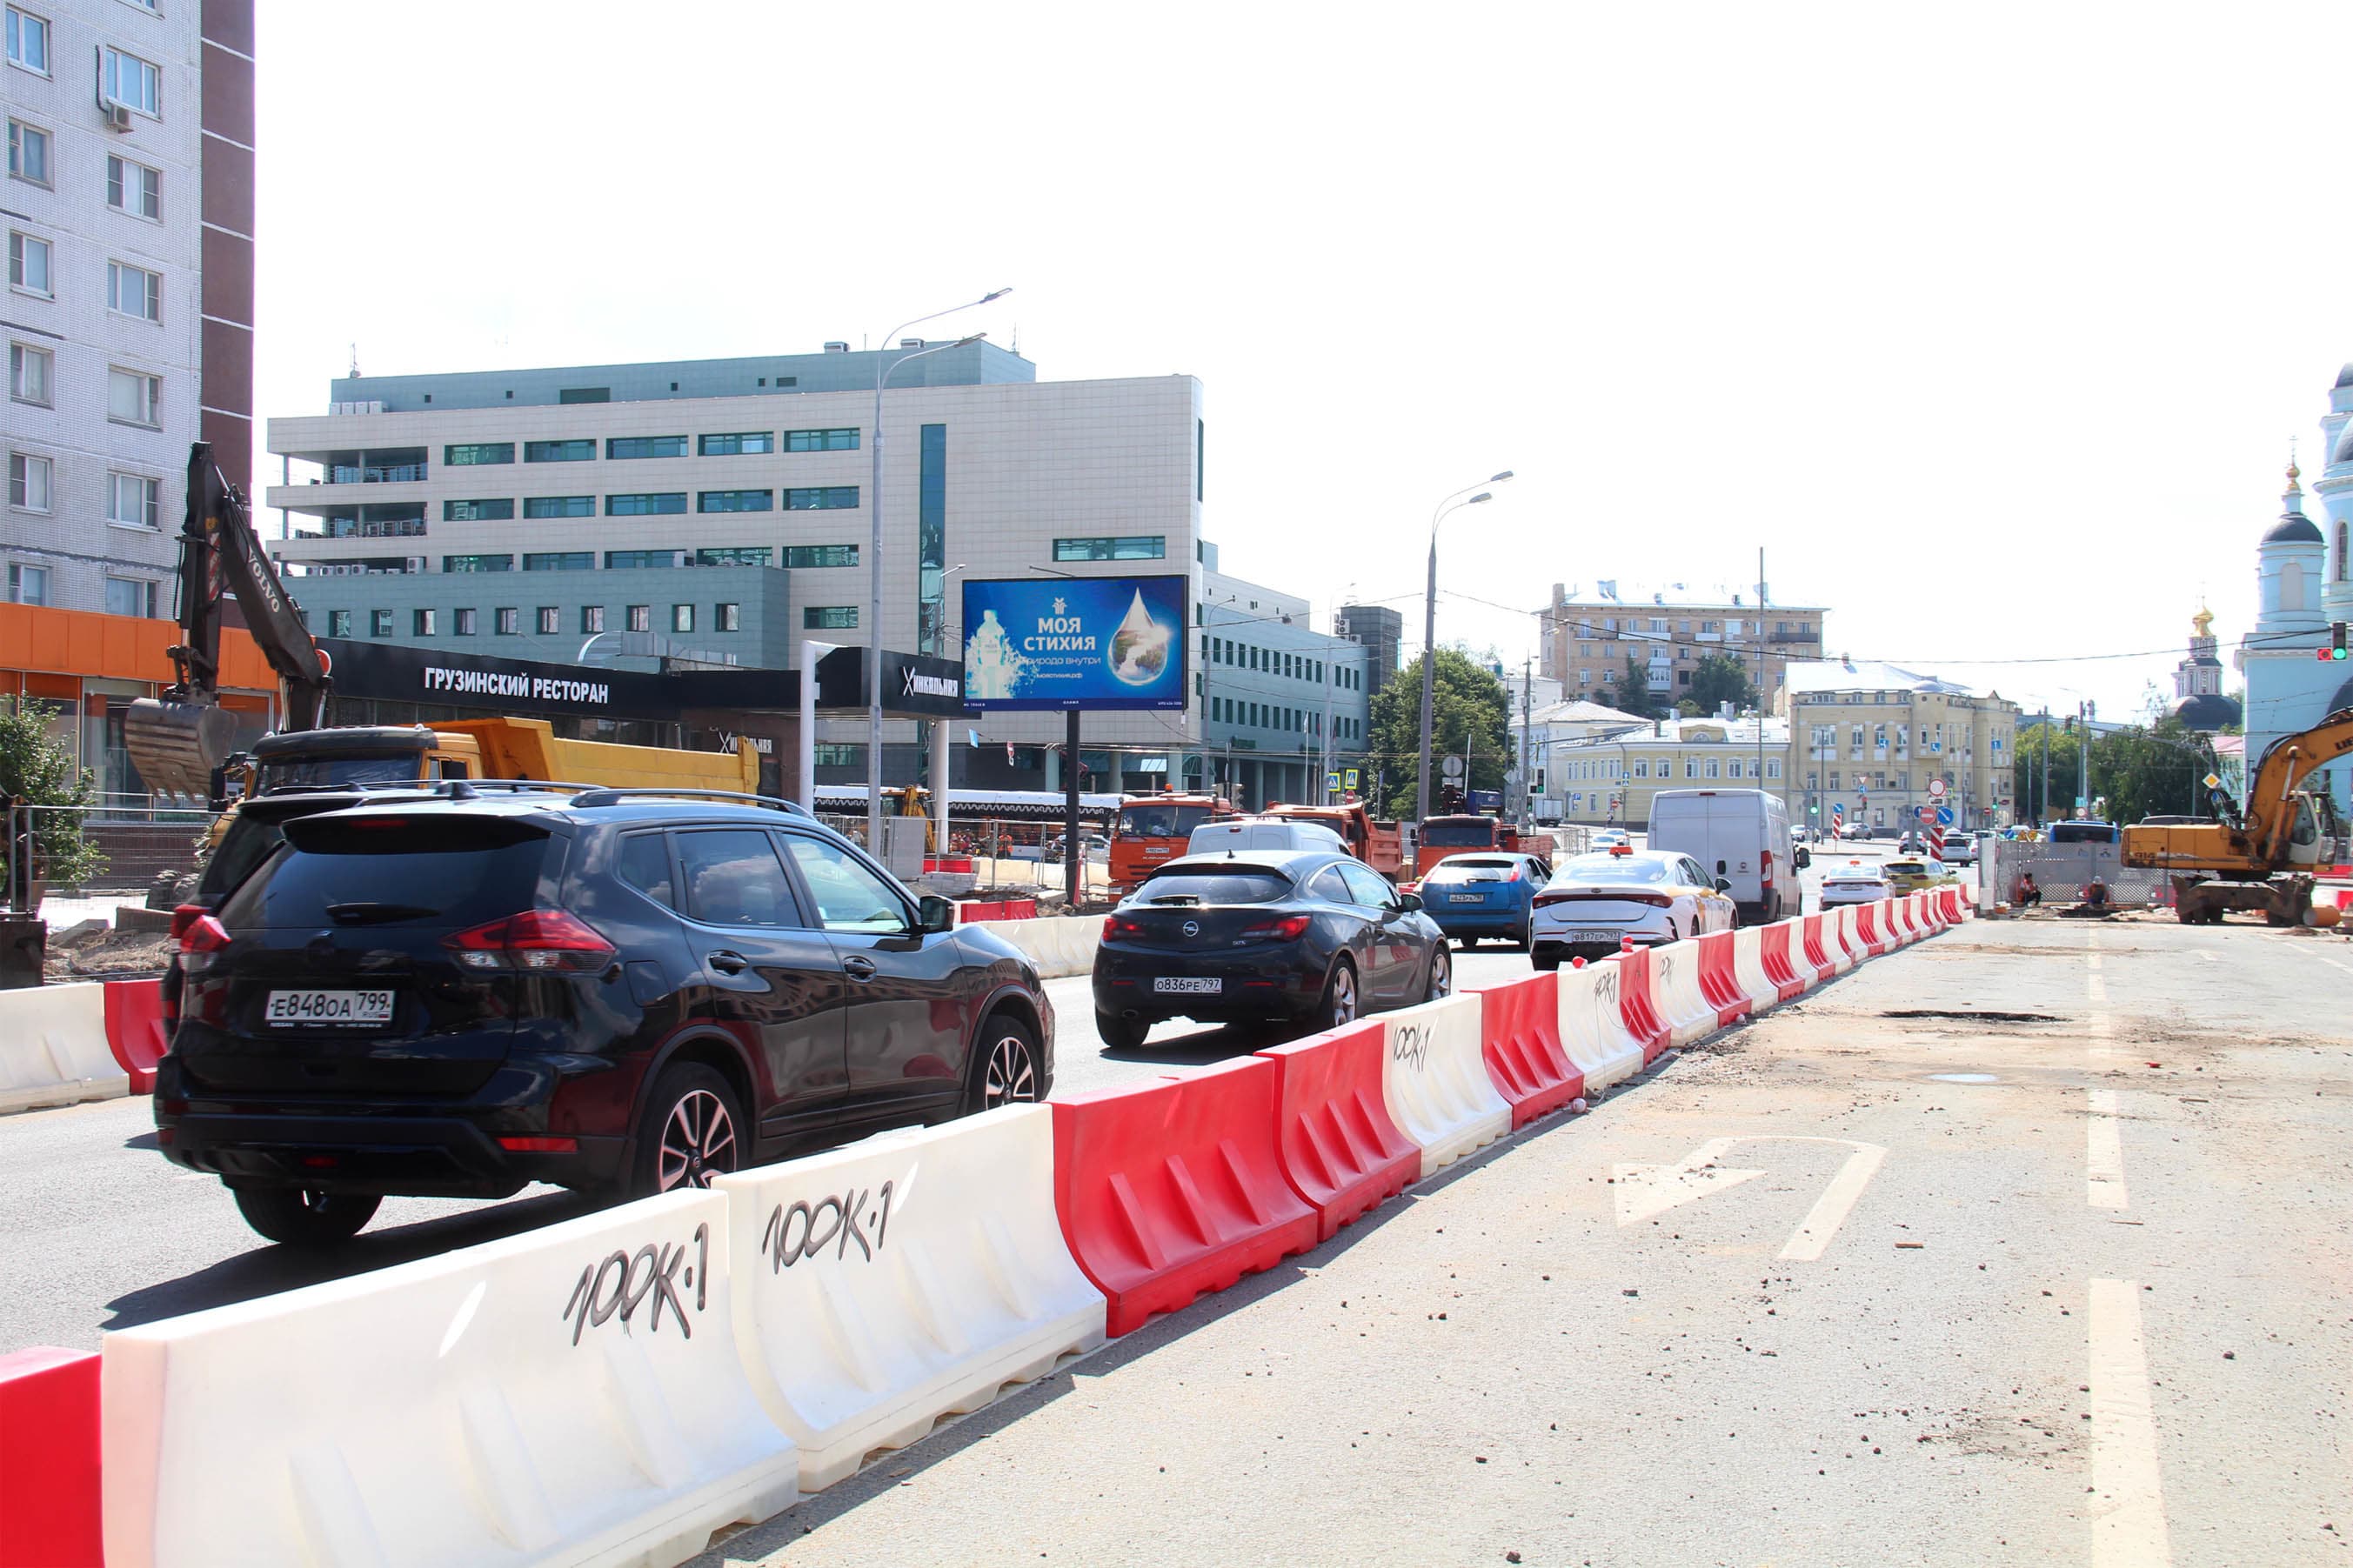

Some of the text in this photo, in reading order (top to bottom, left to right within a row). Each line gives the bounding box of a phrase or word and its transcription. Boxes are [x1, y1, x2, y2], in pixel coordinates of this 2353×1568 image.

[248, 544, 279, 613] VOLVO
[1038, 617, 1081, 634] МОЯ
[1024, 636, 1096, 651] СТИХИЯ
[424, 667, 609, 704] ГРУЗИНСКИЙ РЕСТОРАН
[358, 992, 388, 1011] 799
